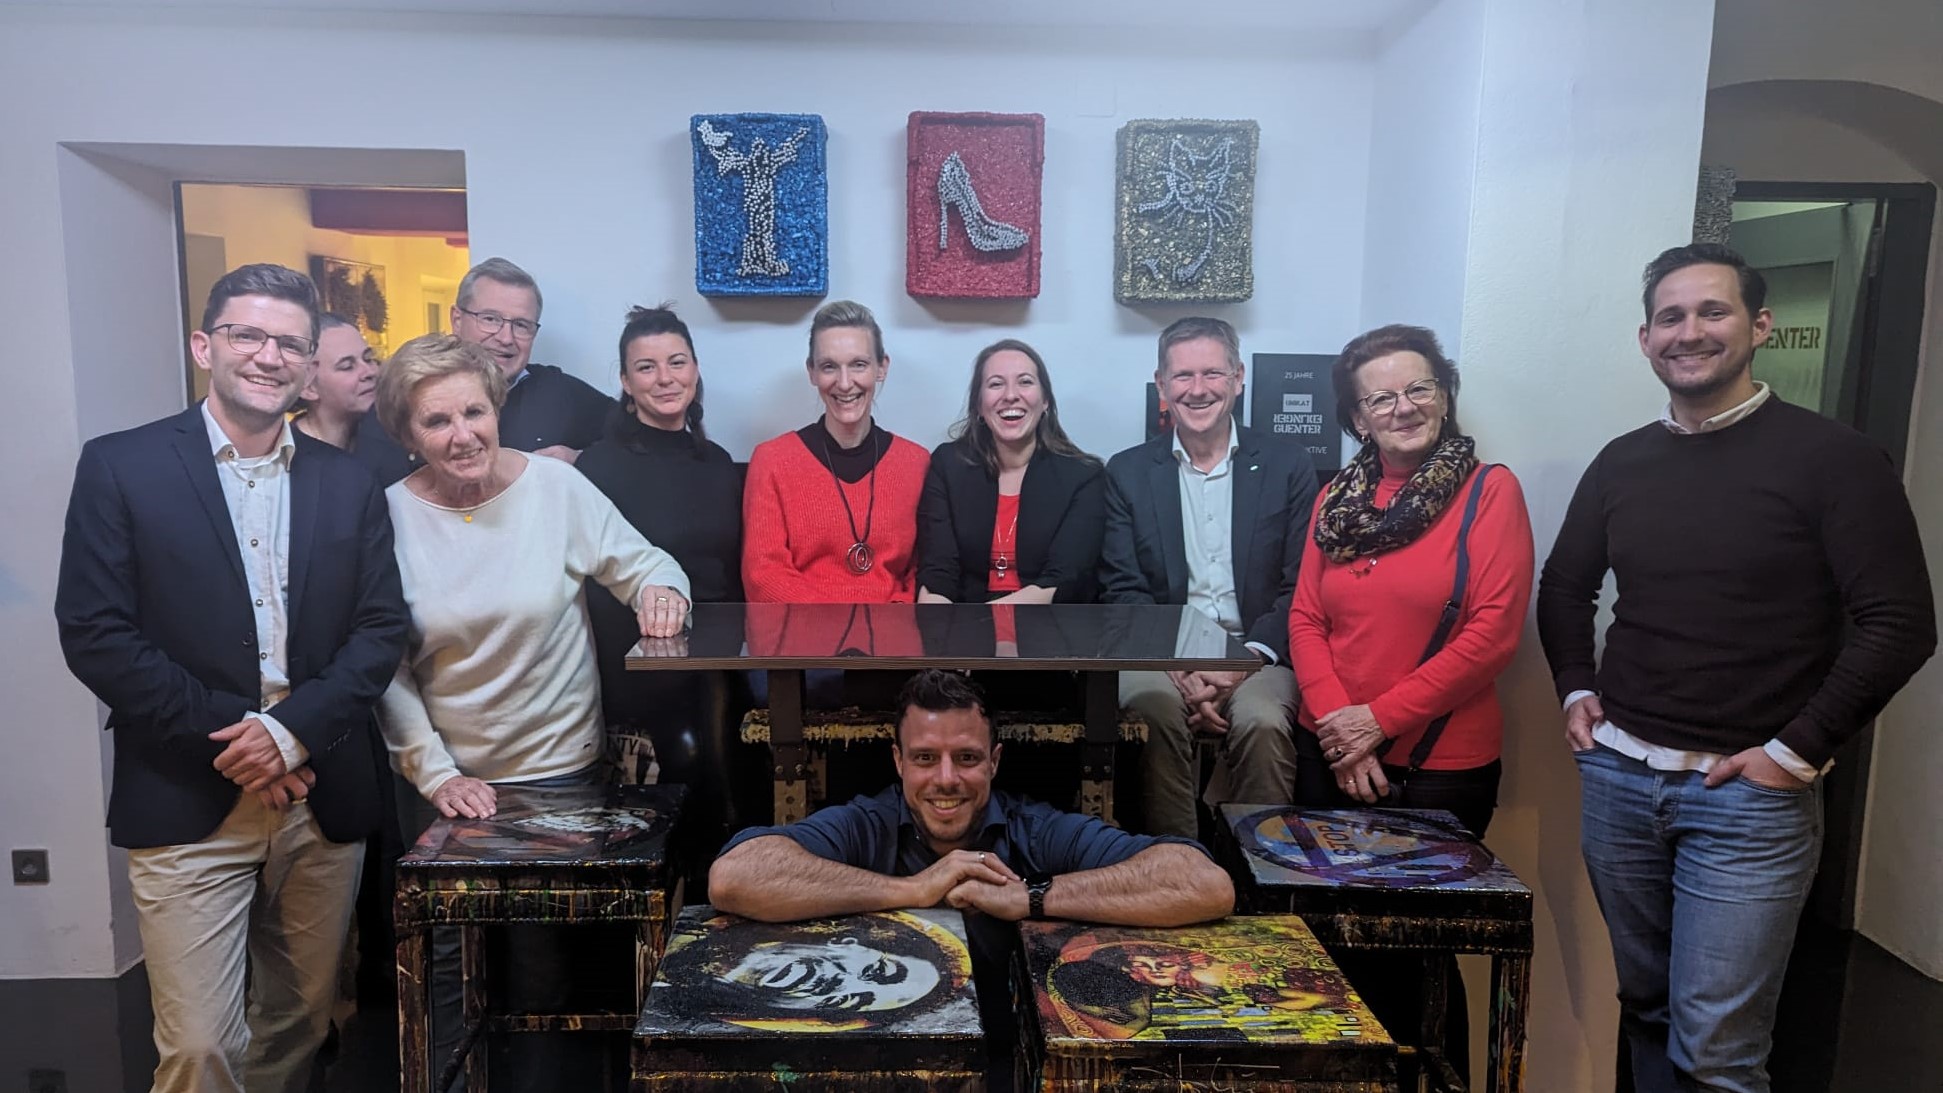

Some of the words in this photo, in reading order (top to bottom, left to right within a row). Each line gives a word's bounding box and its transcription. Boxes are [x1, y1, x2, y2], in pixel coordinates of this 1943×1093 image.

[1293, 371, 1315, 380] JAHRE
[1273, 424, 1321, 434] GUENTER
[1317, 825, 1361, 857] STOP
